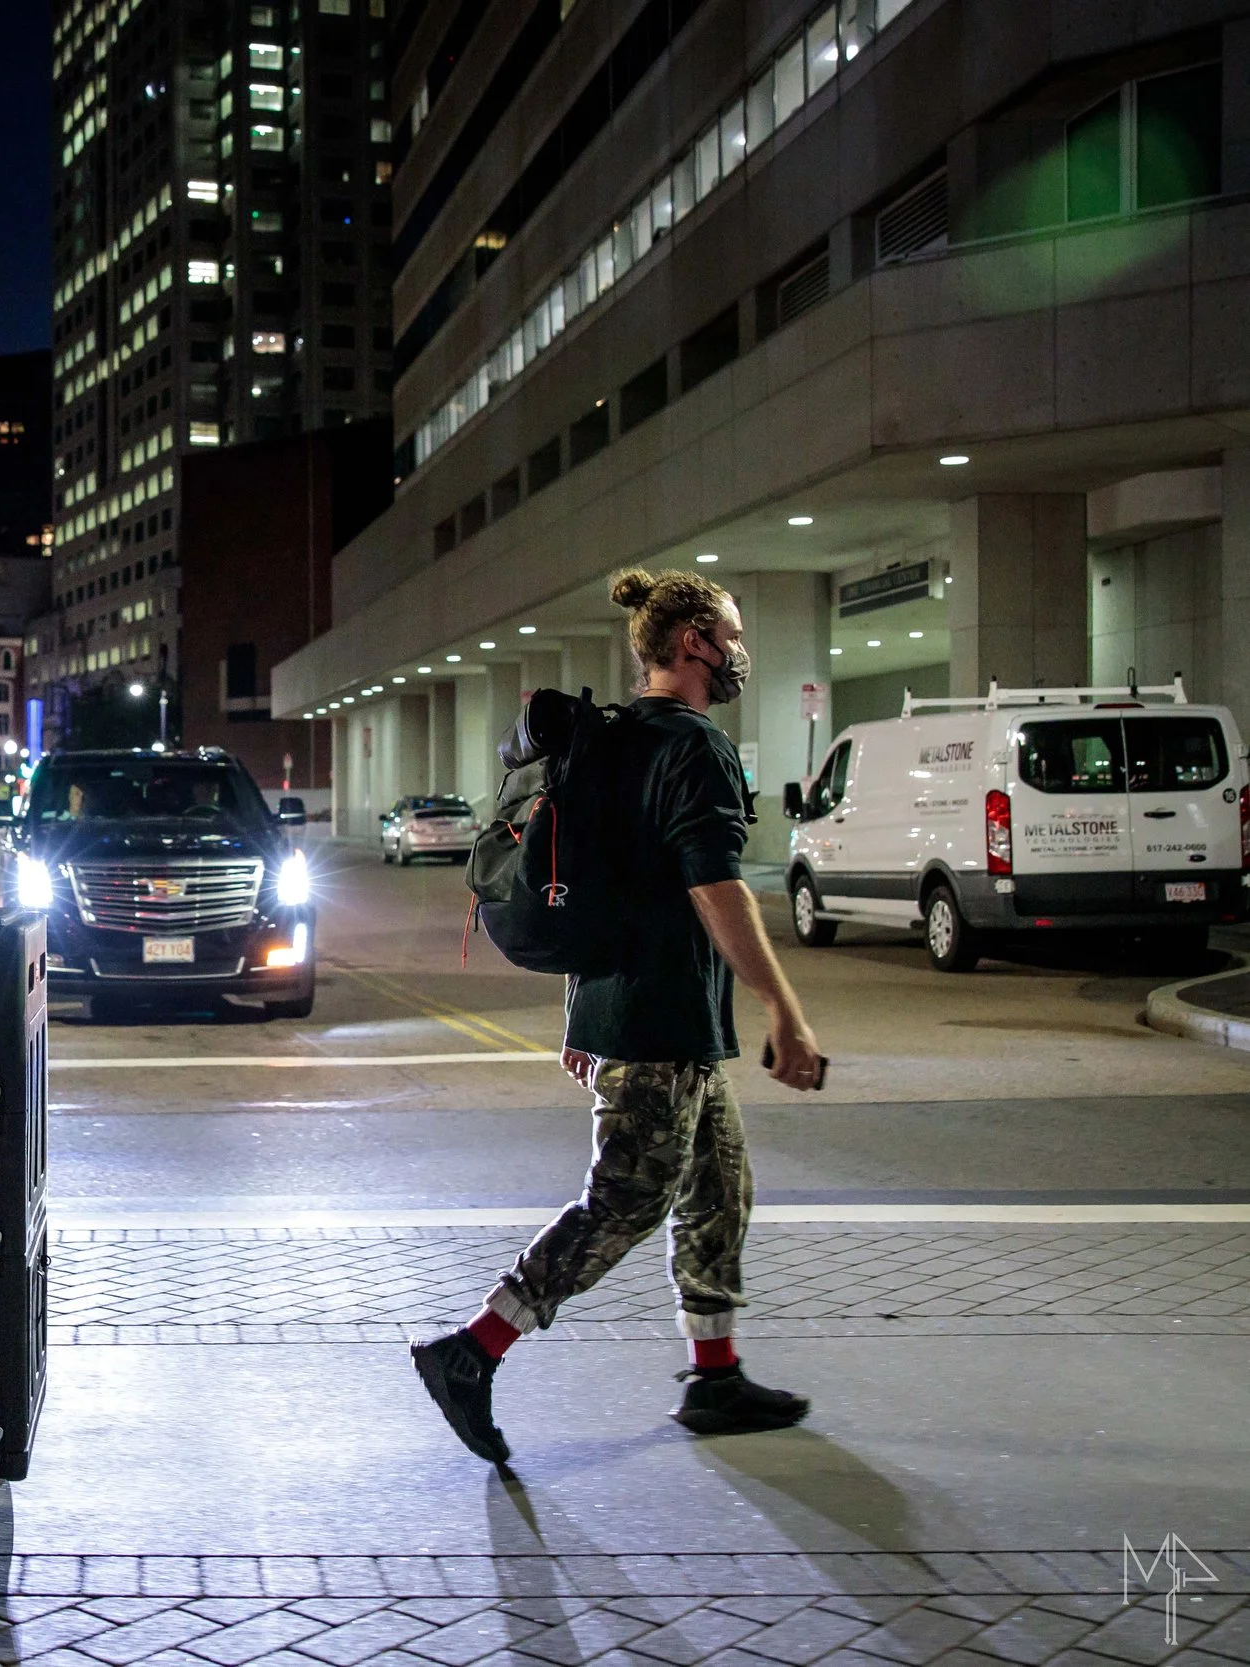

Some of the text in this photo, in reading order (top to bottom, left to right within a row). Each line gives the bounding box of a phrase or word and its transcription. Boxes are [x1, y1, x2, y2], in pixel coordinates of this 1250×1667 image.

[918, 741, 974, 765] METALSTONE
[1024, 820, 1118, 837] METALSTONE
[1025, 836, 1120, 845] TECHNOLOGIES
